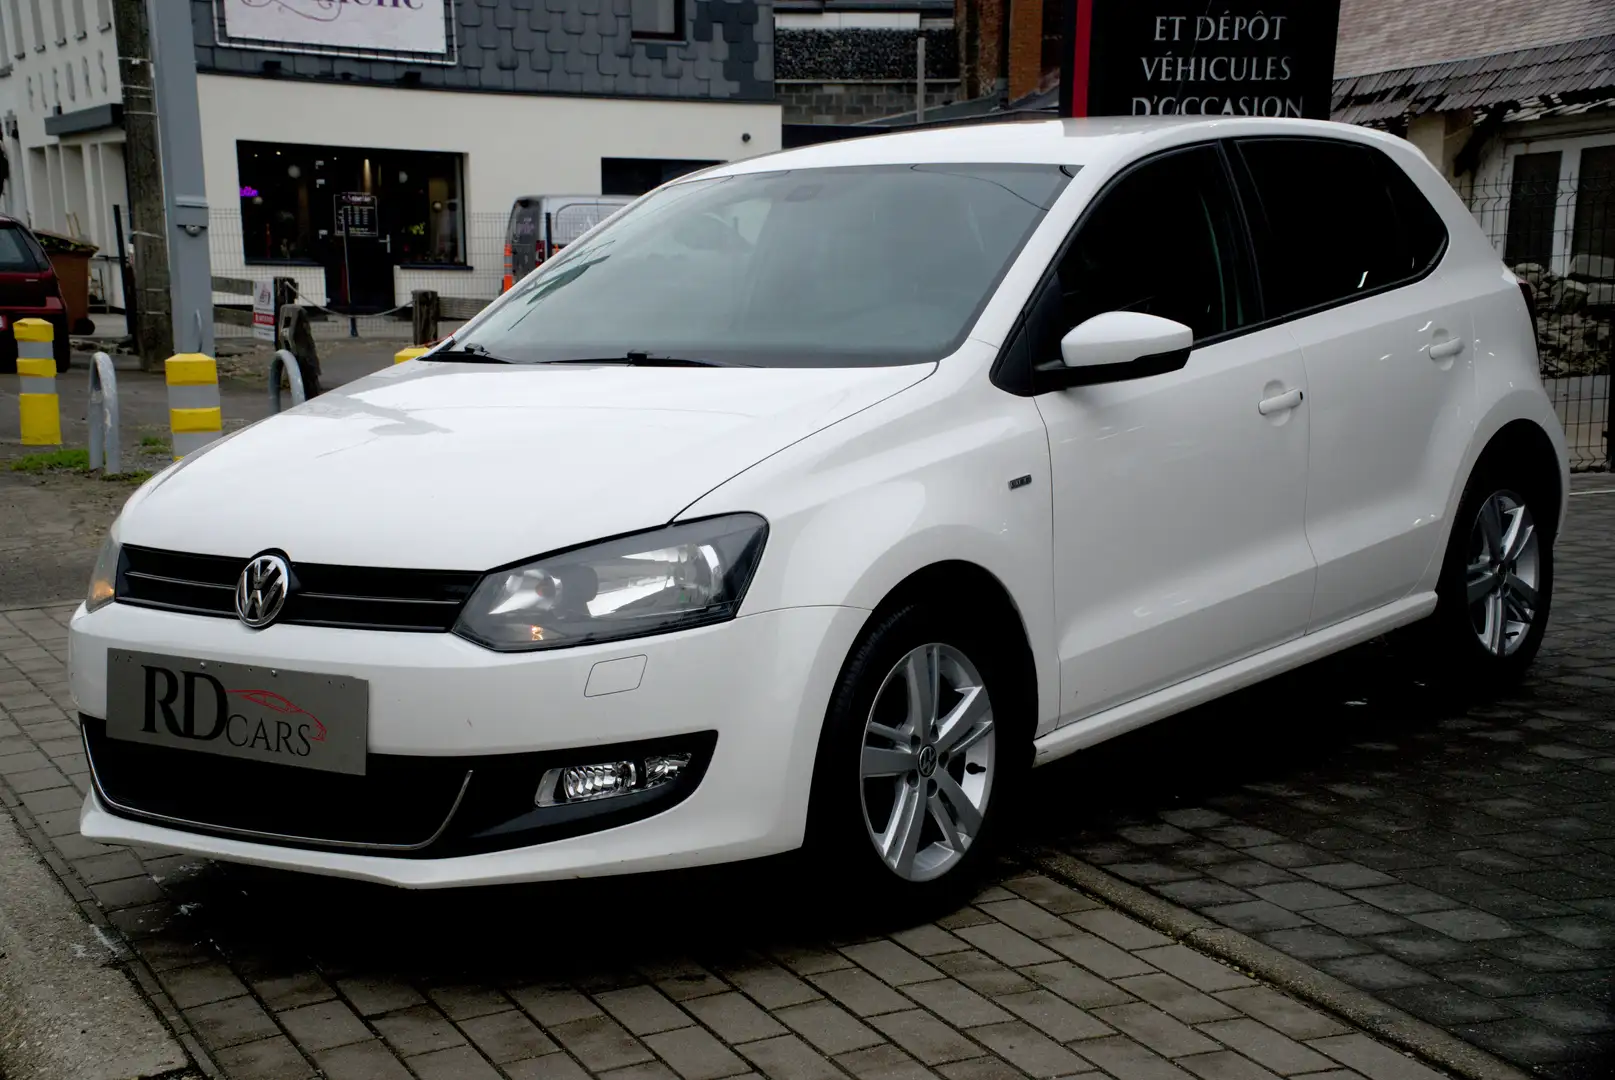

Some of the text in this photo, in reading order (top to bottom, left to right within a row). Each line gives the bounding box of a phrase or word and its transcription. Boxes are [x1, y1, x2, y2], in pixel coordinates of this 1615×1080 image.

[1153, 10, 1287, 41] ET DÉPÔT
[1140, 51, 1292, 81] VÉHICULES
[1132, 95, 1304, 118] D'OCCASION
[225, 713, 312, 757] CARS
